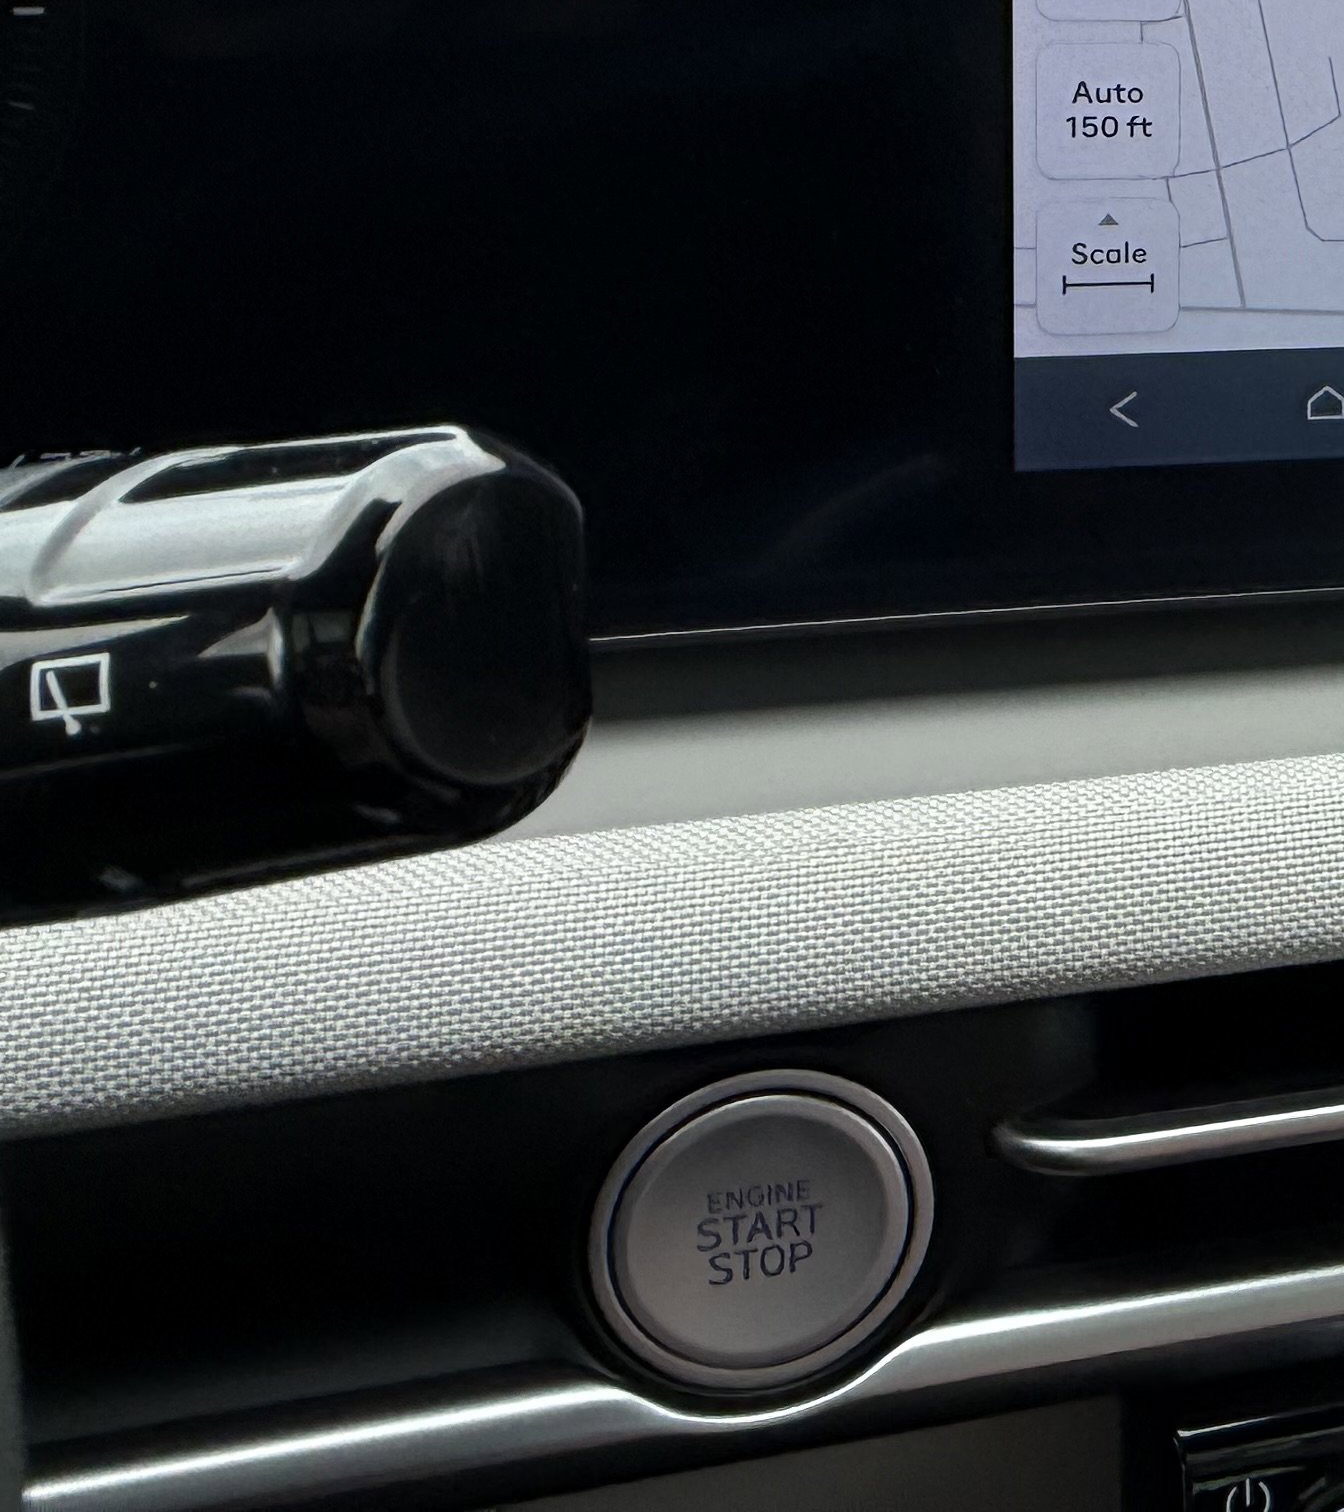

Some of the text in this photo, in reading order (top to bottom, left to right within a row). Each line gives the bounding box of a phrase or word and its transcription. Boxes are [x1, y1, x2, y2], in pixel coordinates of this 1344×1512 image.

[1071, 80, 1144, 105] Auto
[1065, 115, 1153, 139] 150 ft
[1071, 241, 1148, 266] Scale
[706, 1180, 811, 1215] ENGINE
[696, 1202, 824, 1252] START
[708, 1239, 814, 1286] STOP
